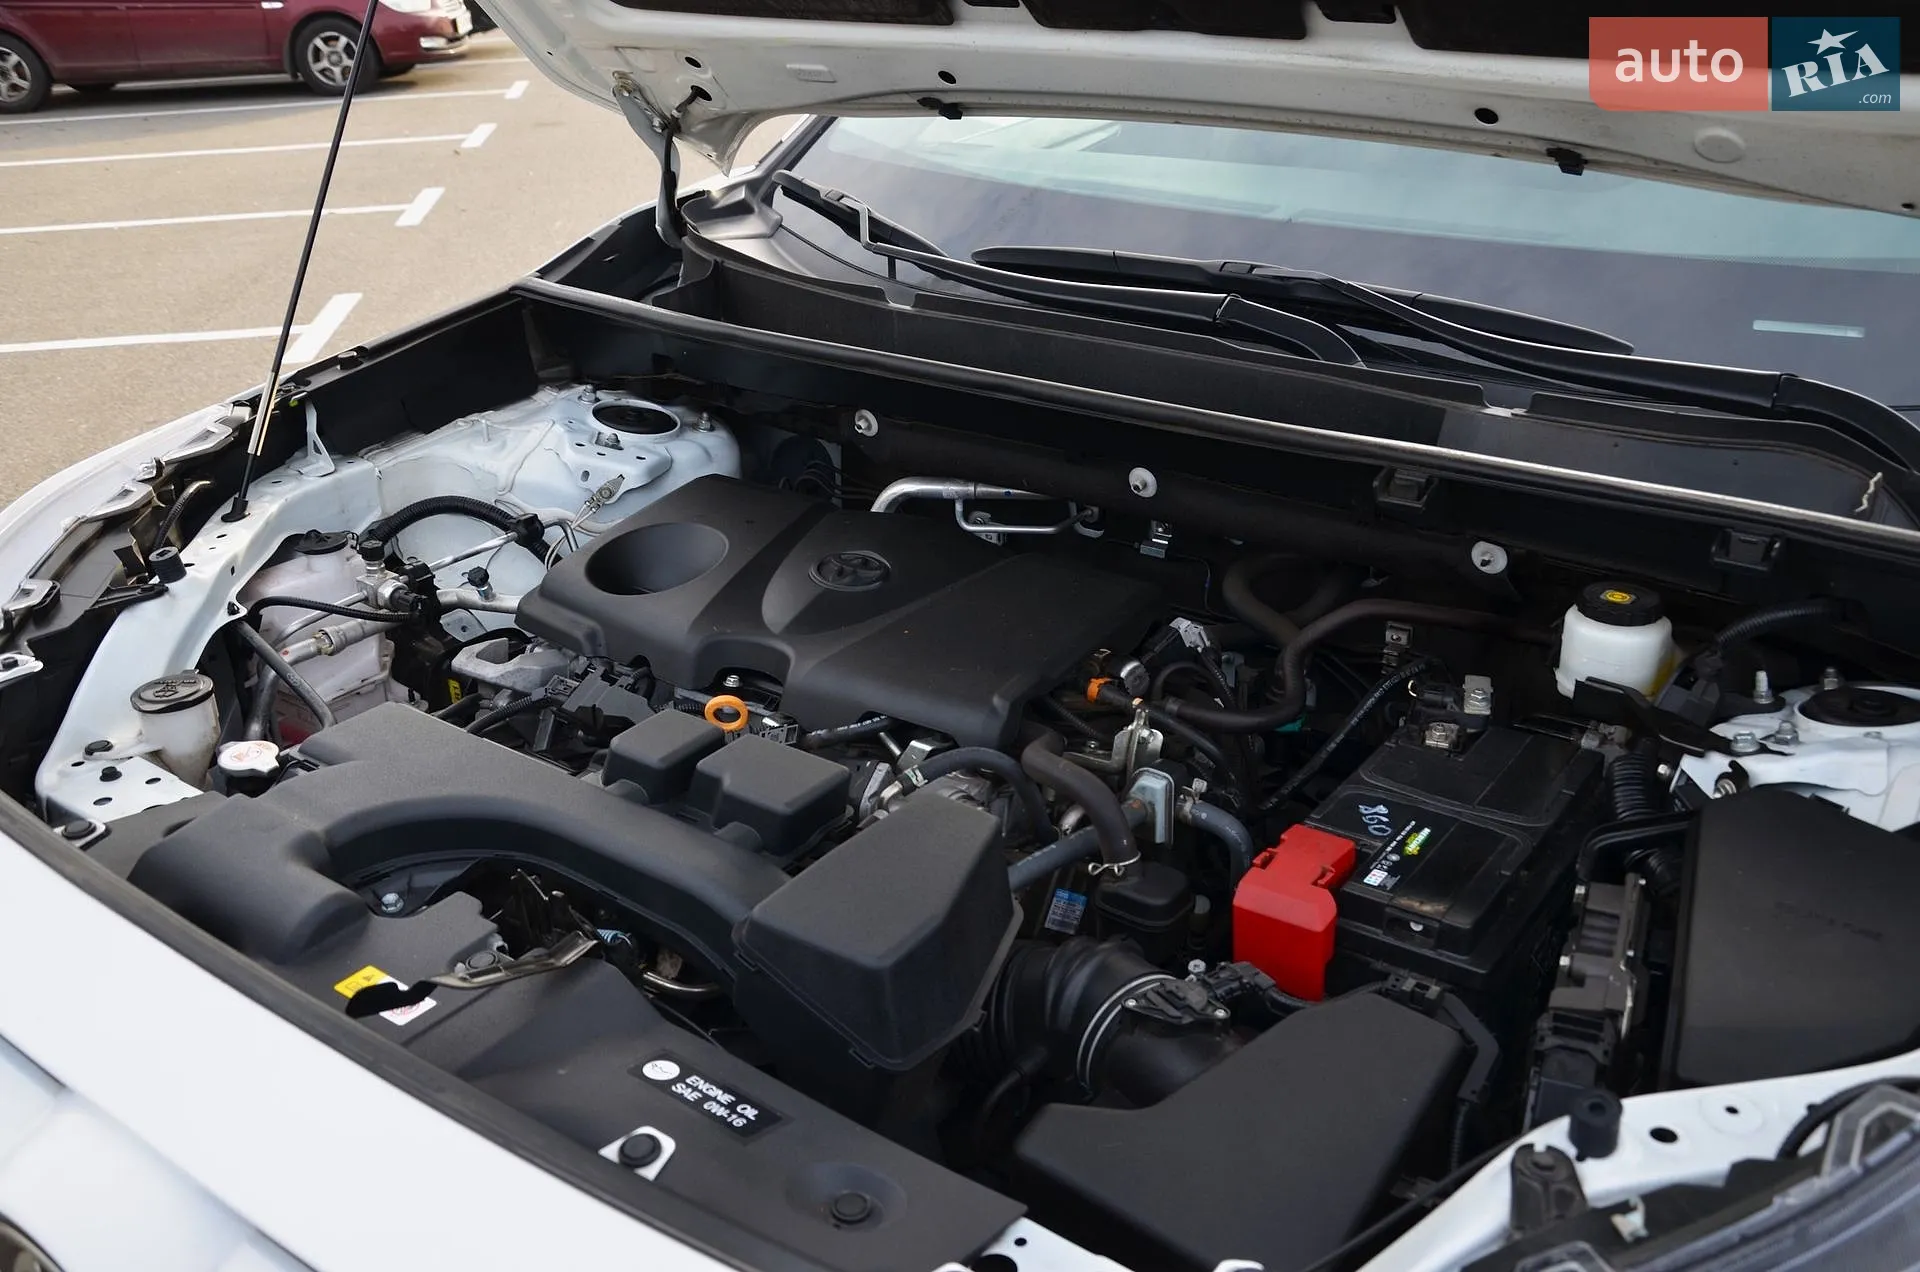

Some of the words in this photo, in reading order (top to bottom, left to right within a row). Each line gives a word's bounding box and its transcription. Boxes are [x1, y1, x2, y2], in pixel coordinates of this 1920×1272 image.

[671, 1082, 703, 1102] SAE
[703, 1100, 748, 1127] 0W-16
[685, 1075, 736, 1105] ENGINE
[736, 1103, 759, 1120] OIL
